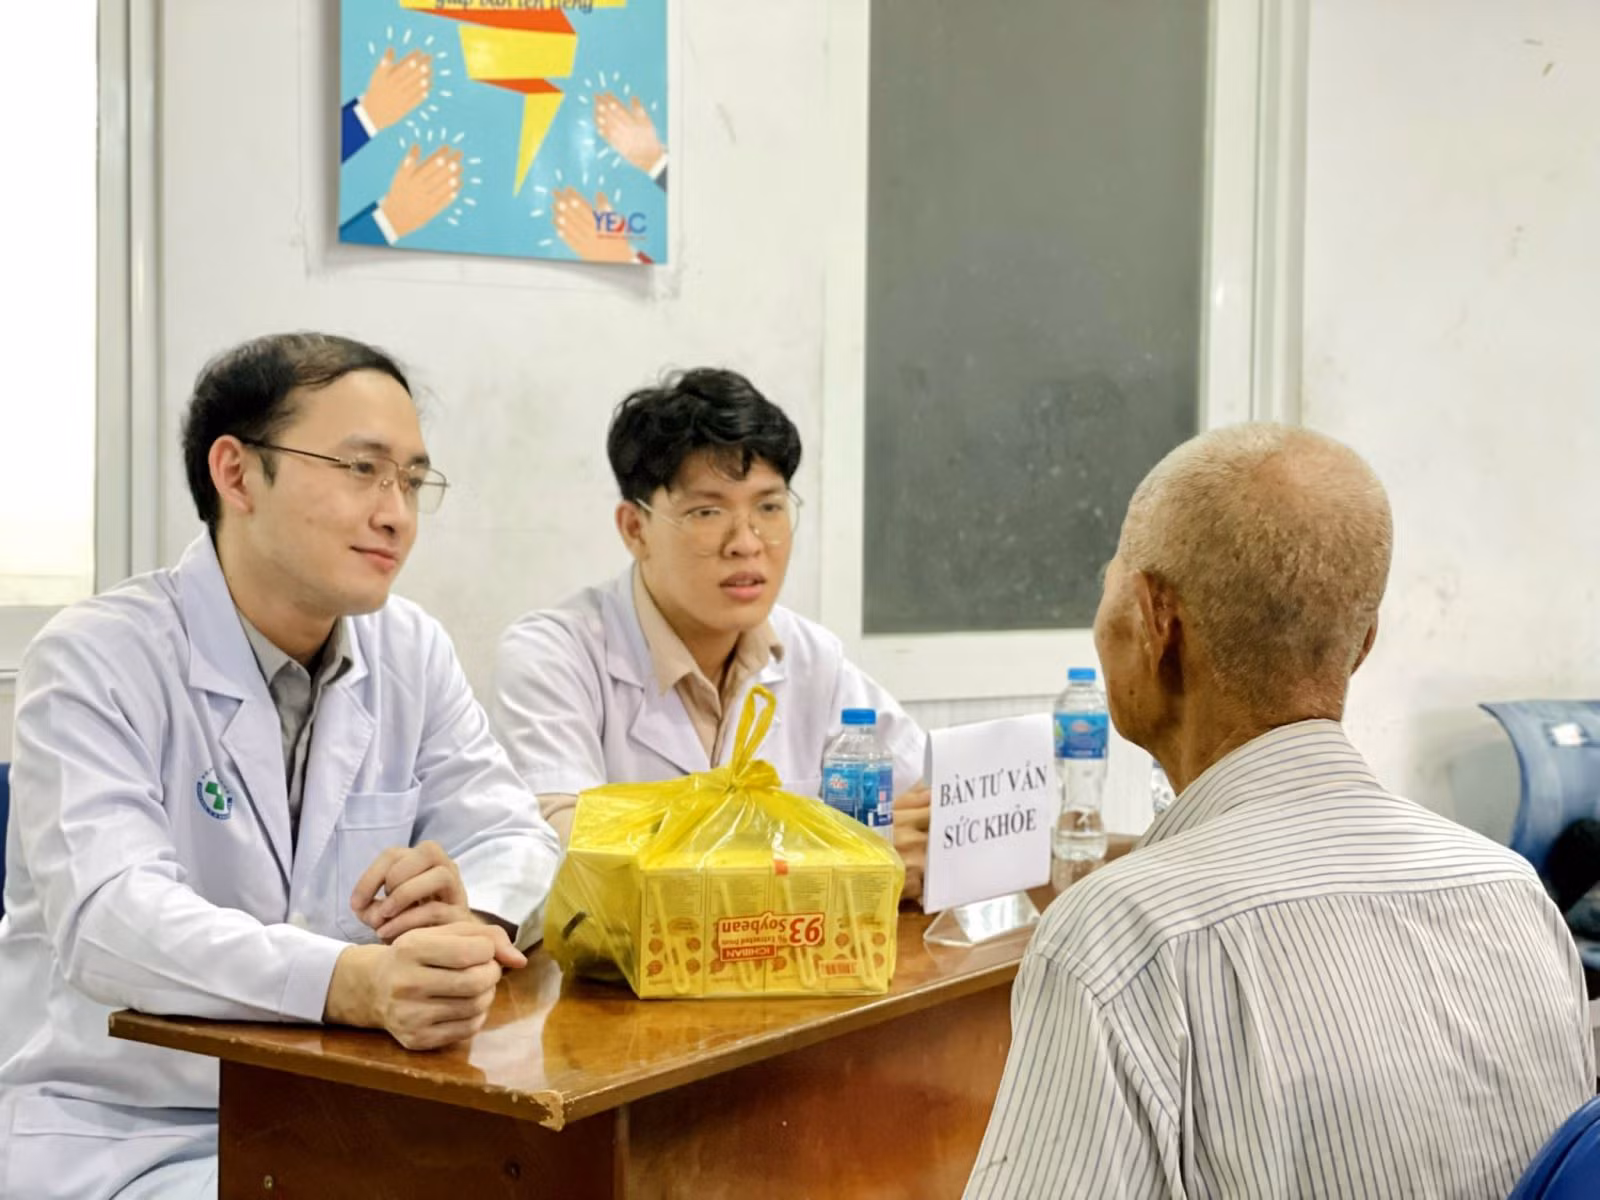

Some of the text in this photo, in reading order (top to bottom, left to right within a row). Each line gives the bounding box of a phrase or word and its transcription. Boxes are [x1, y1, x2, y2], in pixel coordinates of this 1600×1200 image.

[940, 760, 1048, 807] BÀN TƯ VẤN
[943, 804, 1037, 849] SỨC KHỎE
[722, 915, 788, 934] Soybean
[789, 917, 821, 943] 93
[725, 946, 771, 958] ICHIBAN
